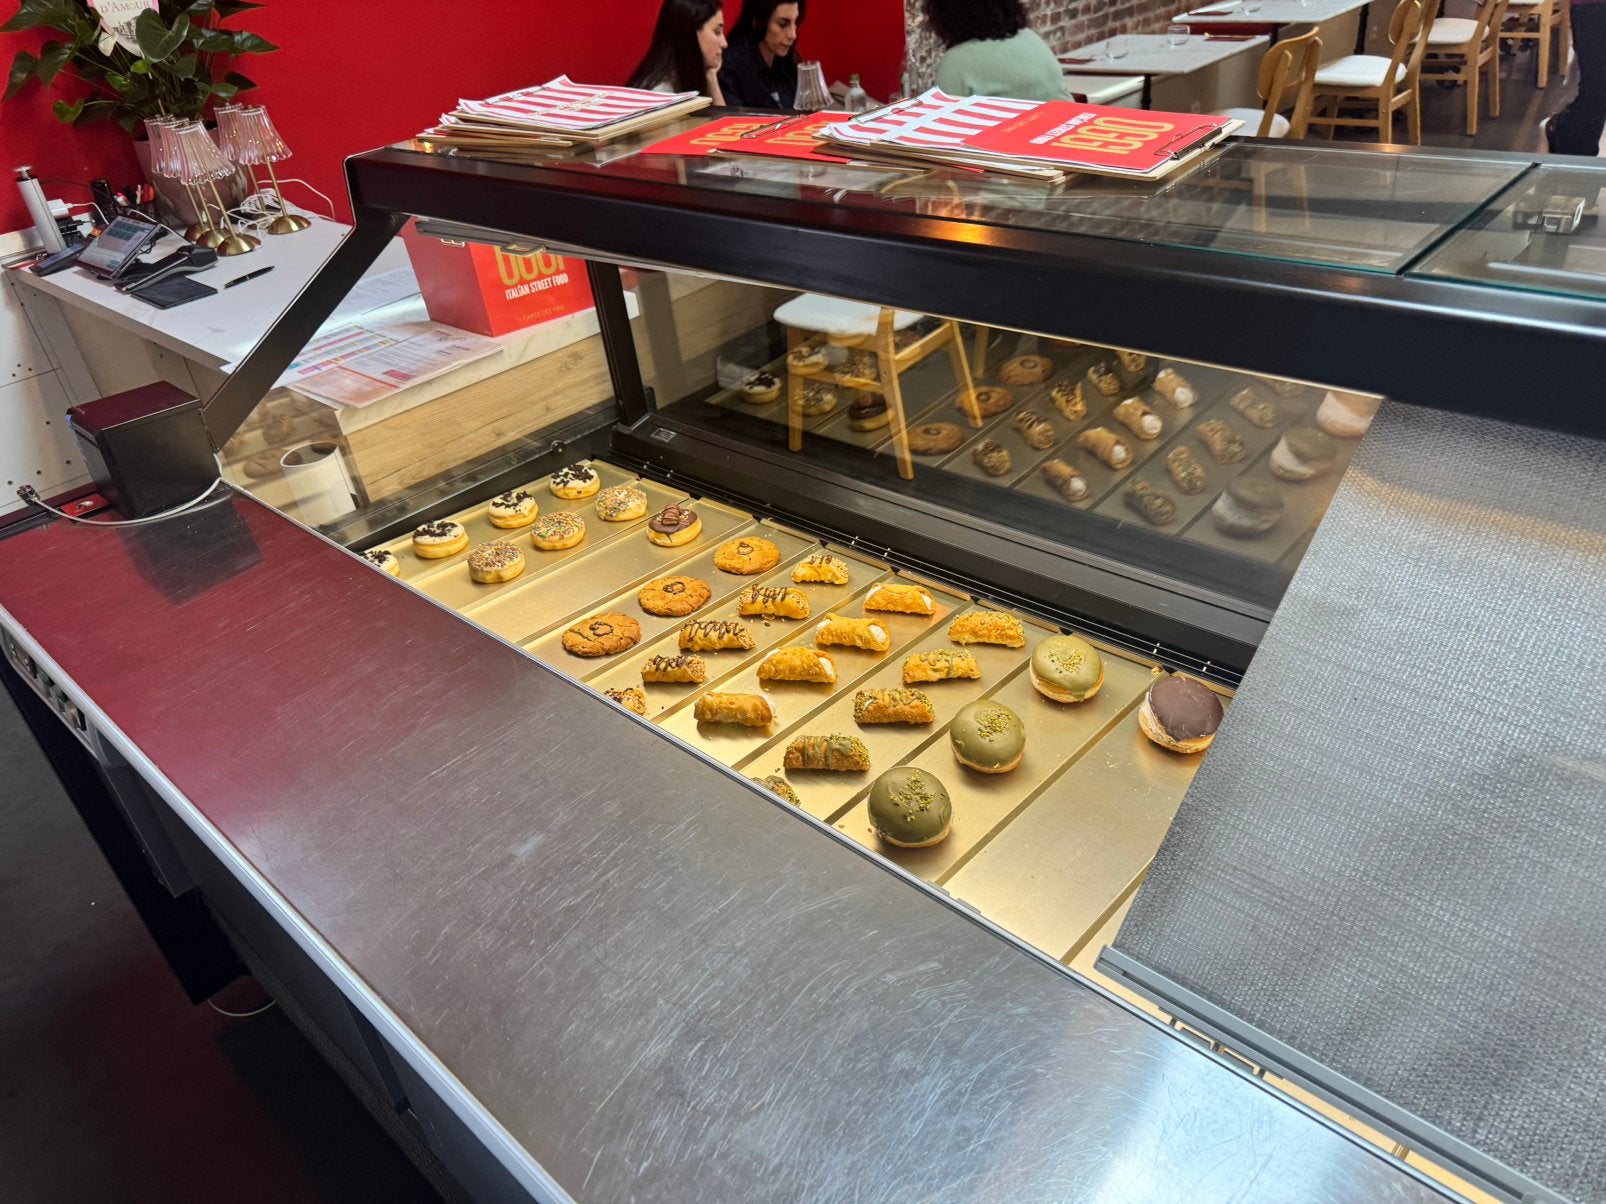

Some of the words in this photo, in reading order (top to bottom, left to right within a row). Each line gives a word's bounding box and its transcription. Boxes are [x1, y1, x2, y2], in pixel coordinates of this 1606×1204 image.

[504, 284, 530, 301] ITALIAN
[529, 277, 553, 293] STREET
[552, 273, 569, 287] FOOD
